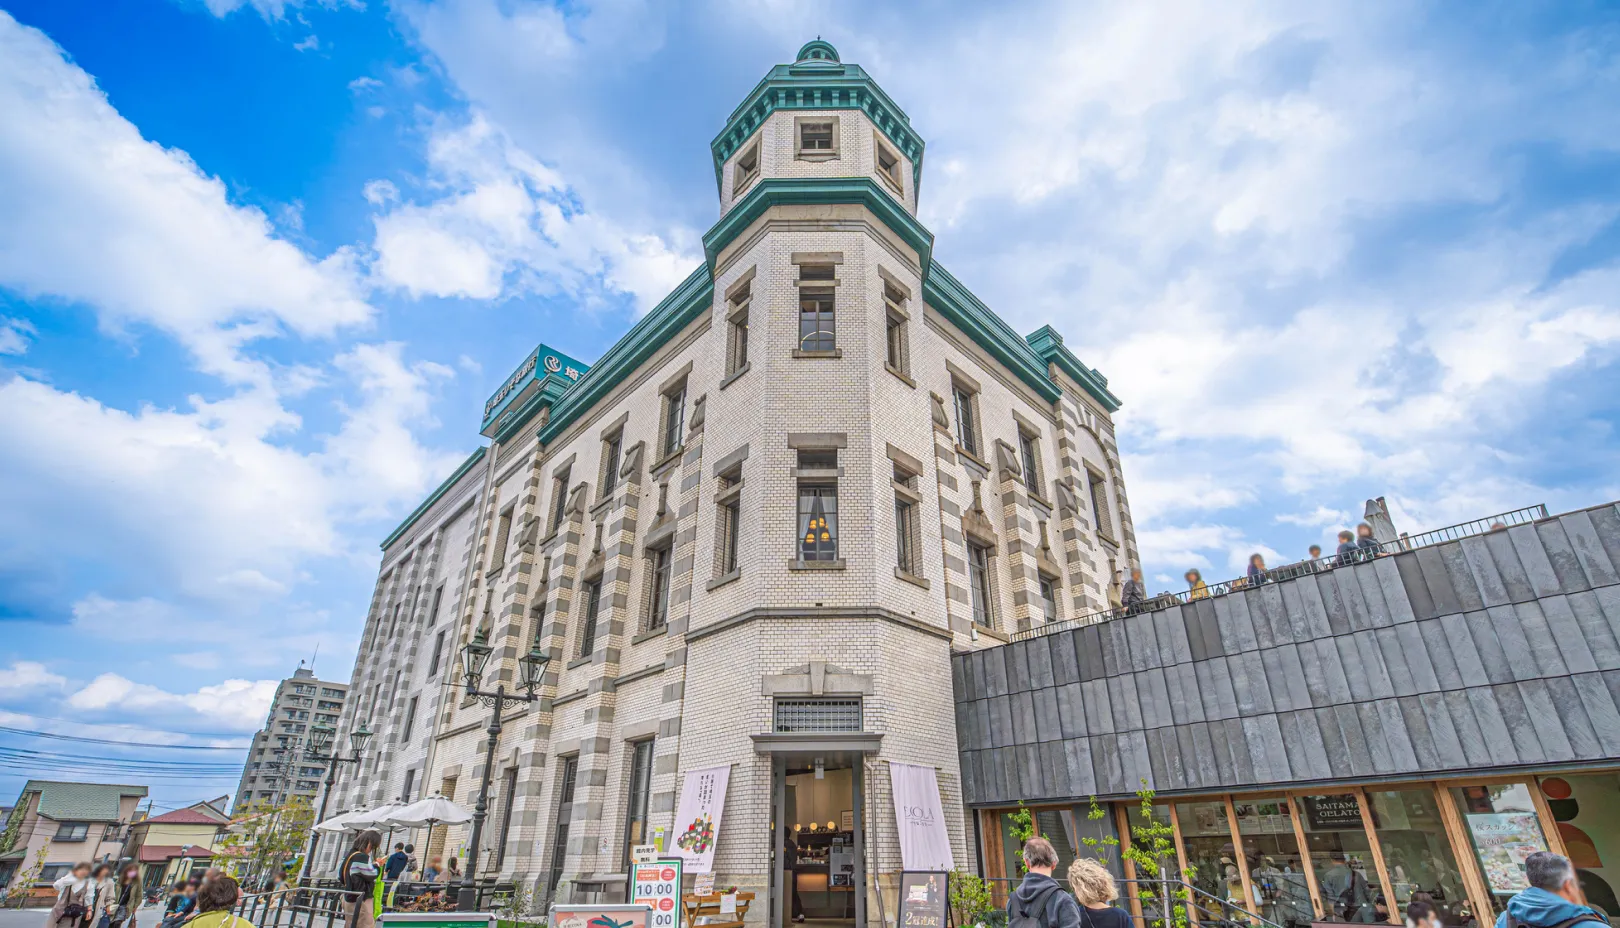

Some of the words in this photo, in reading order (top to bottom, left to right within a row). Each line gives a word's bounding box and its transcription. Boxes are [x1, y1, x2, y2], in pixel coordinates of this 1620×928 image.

[1475, 822, 1521, 831] 桜スカッシ
[637, 884, 672, 895] 10:00
